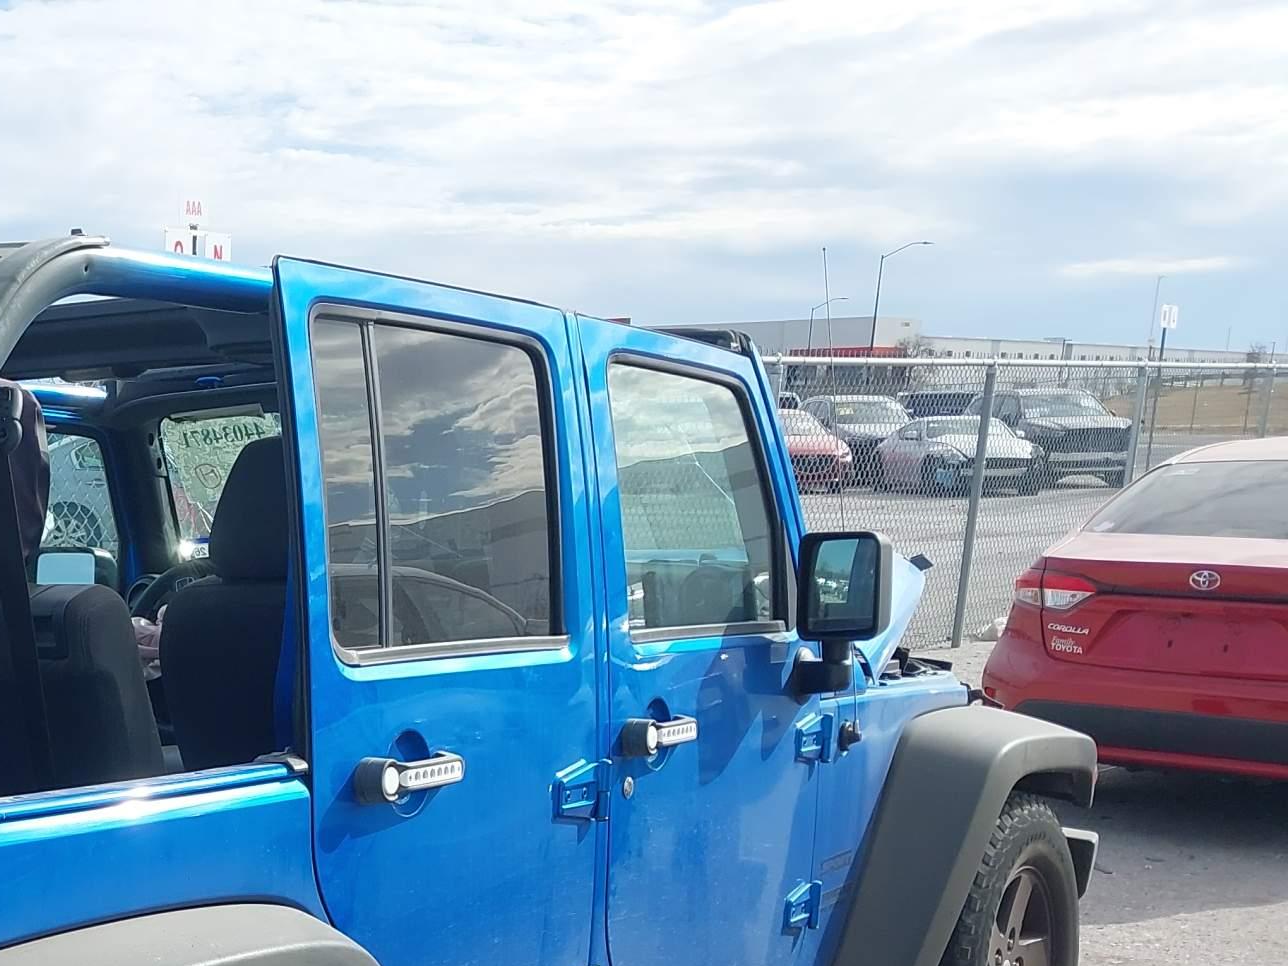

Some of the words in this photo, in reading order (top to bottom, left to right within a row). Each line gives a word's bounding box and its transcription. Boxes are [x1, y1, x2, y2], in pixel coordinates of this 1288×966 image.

[185, 200, 202, 216] AAA
[1047, 623, 1089, 635] COROLLA
[1051, 643, 1083, 654] TOYOTA
